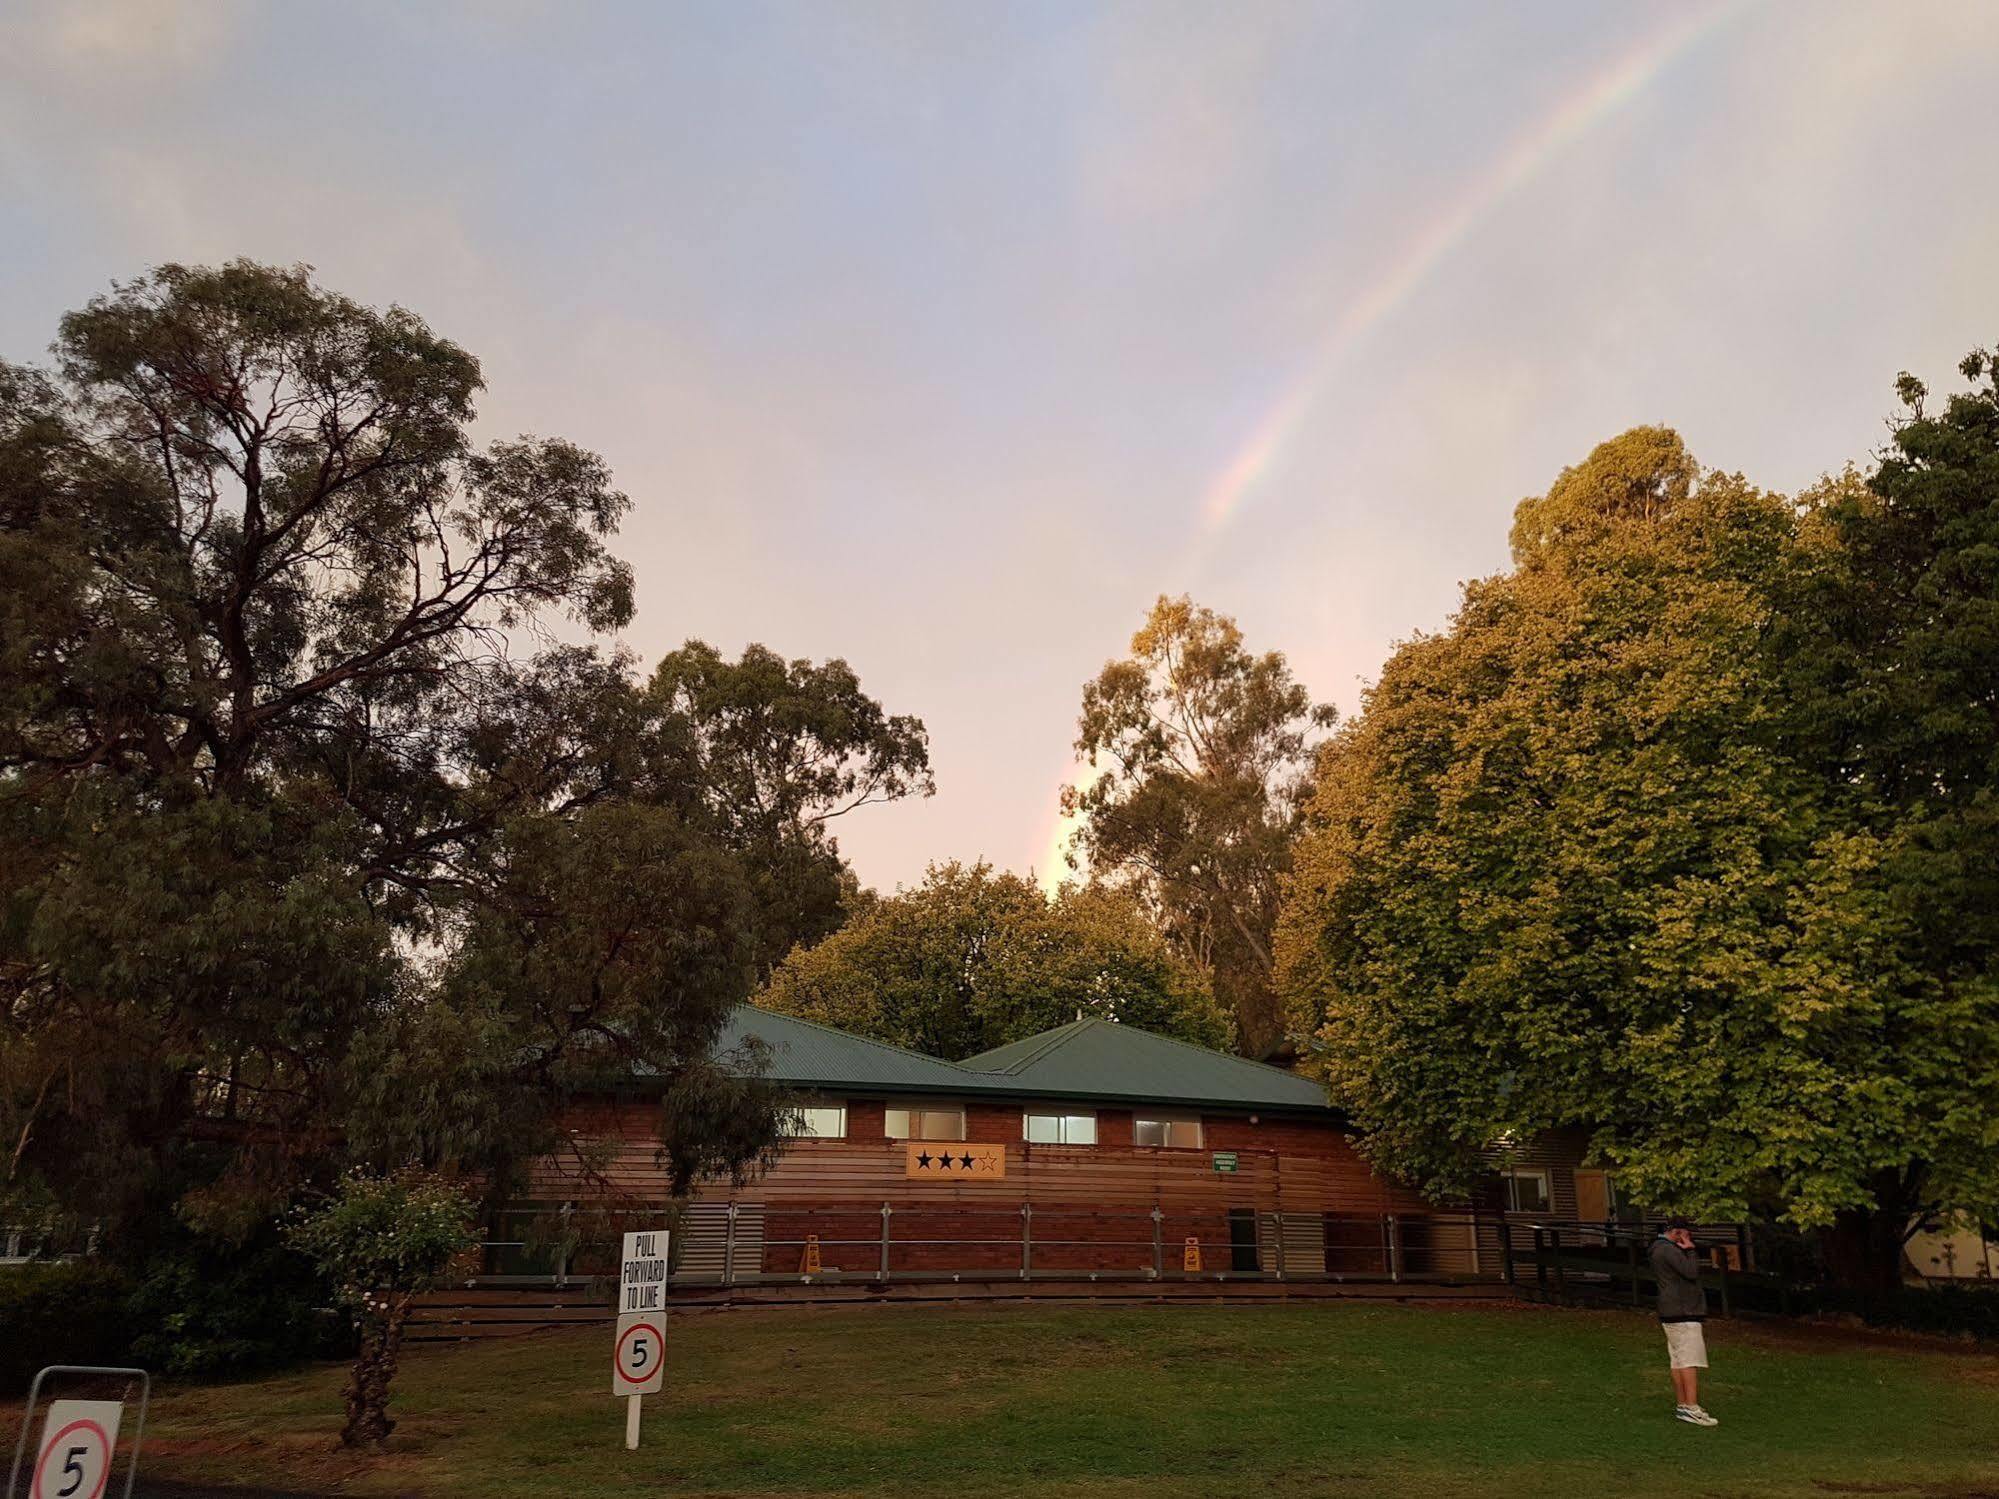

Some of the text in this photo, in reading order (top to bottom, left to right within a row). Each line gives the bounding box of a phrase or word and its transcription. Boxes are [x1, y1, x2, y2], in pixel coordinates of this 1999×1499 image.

[635, 1235, 655, 1257] PULL
[624, 1260, 664, 1284] FORWARD
[628, 1286, 658, 1309] TO LINE
[632, 1339, 647, 1367] 5
[57, 1447, 88, 1497] 5
